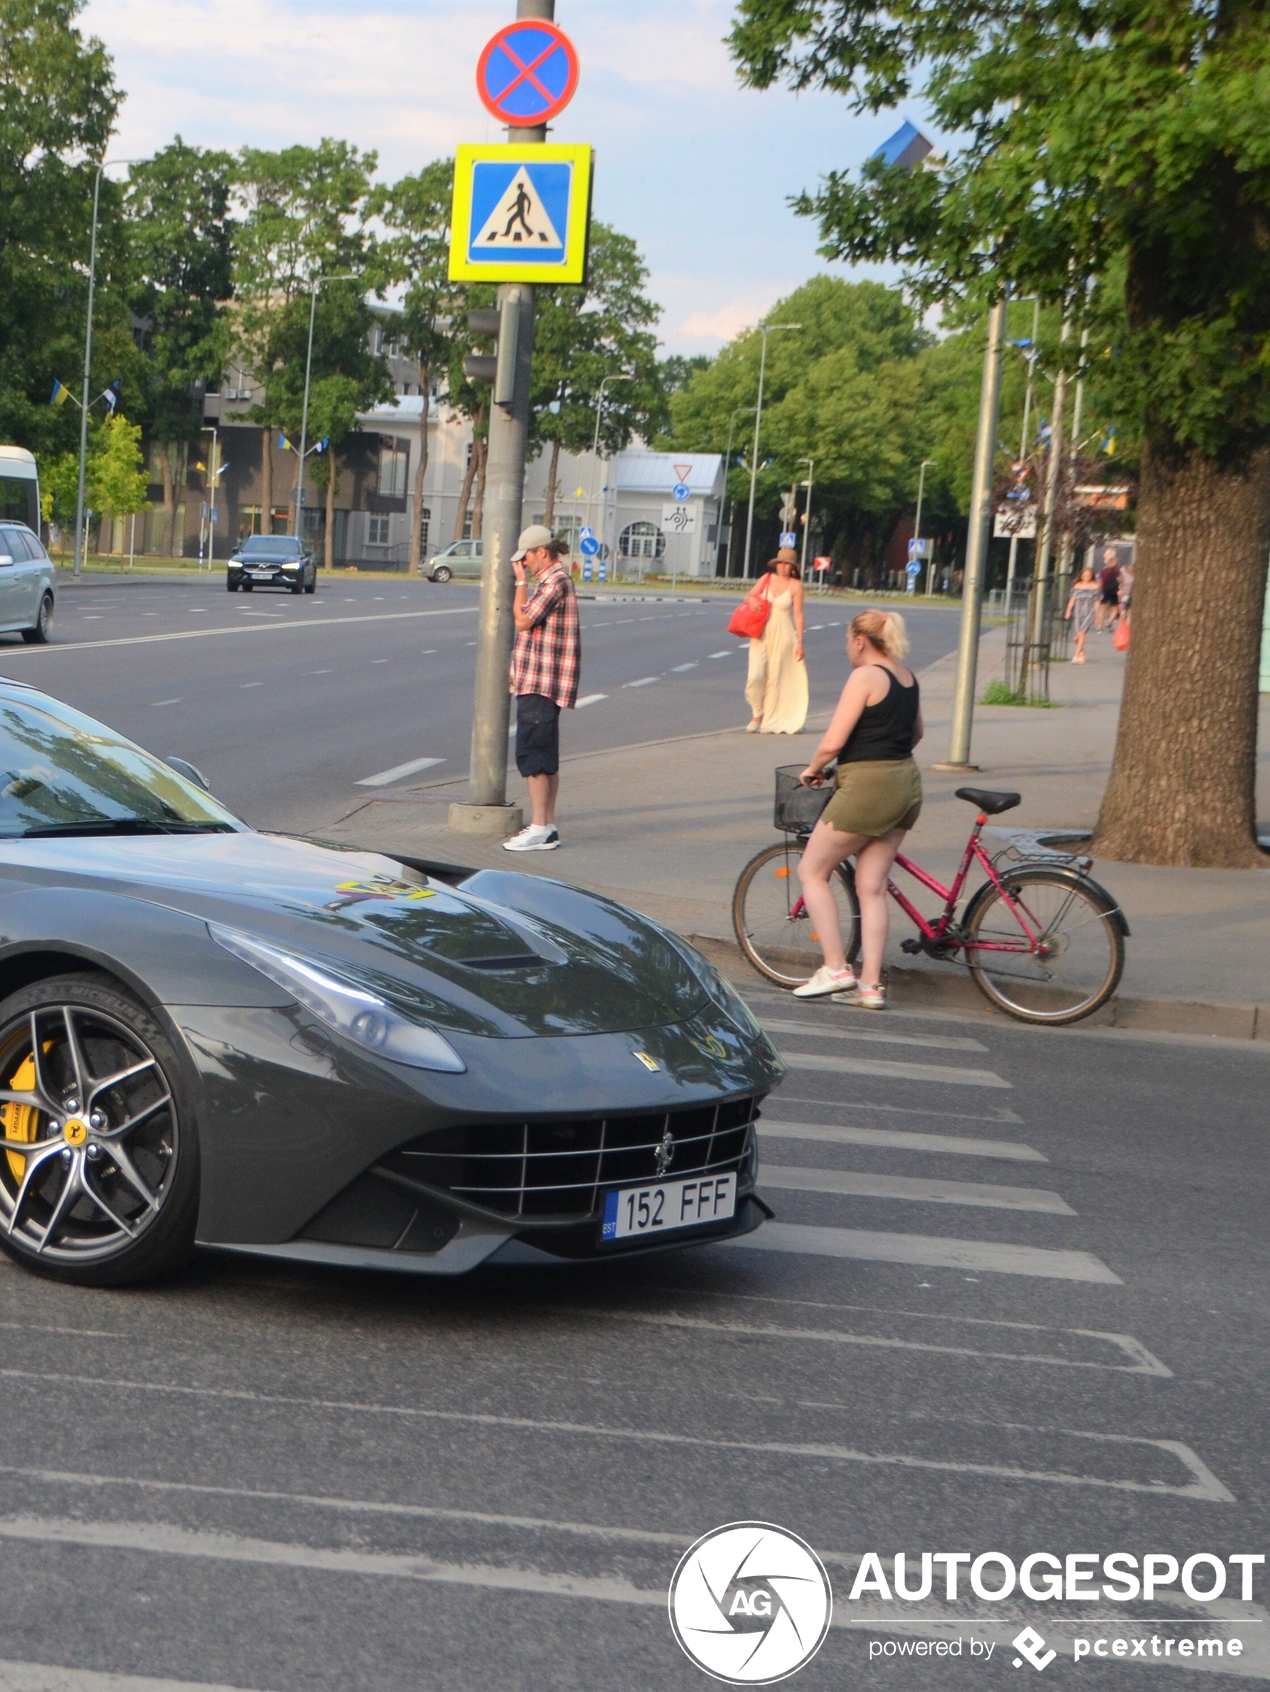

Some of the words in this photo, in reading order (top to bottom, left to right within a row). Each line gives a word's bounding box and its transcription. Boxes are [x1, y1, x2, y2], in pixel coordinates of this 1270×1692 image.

[627, 1189, 665, 1231] 152
[680, 1178, 730, 1221] FFF
[603, 1222, 616, 1234] EST
